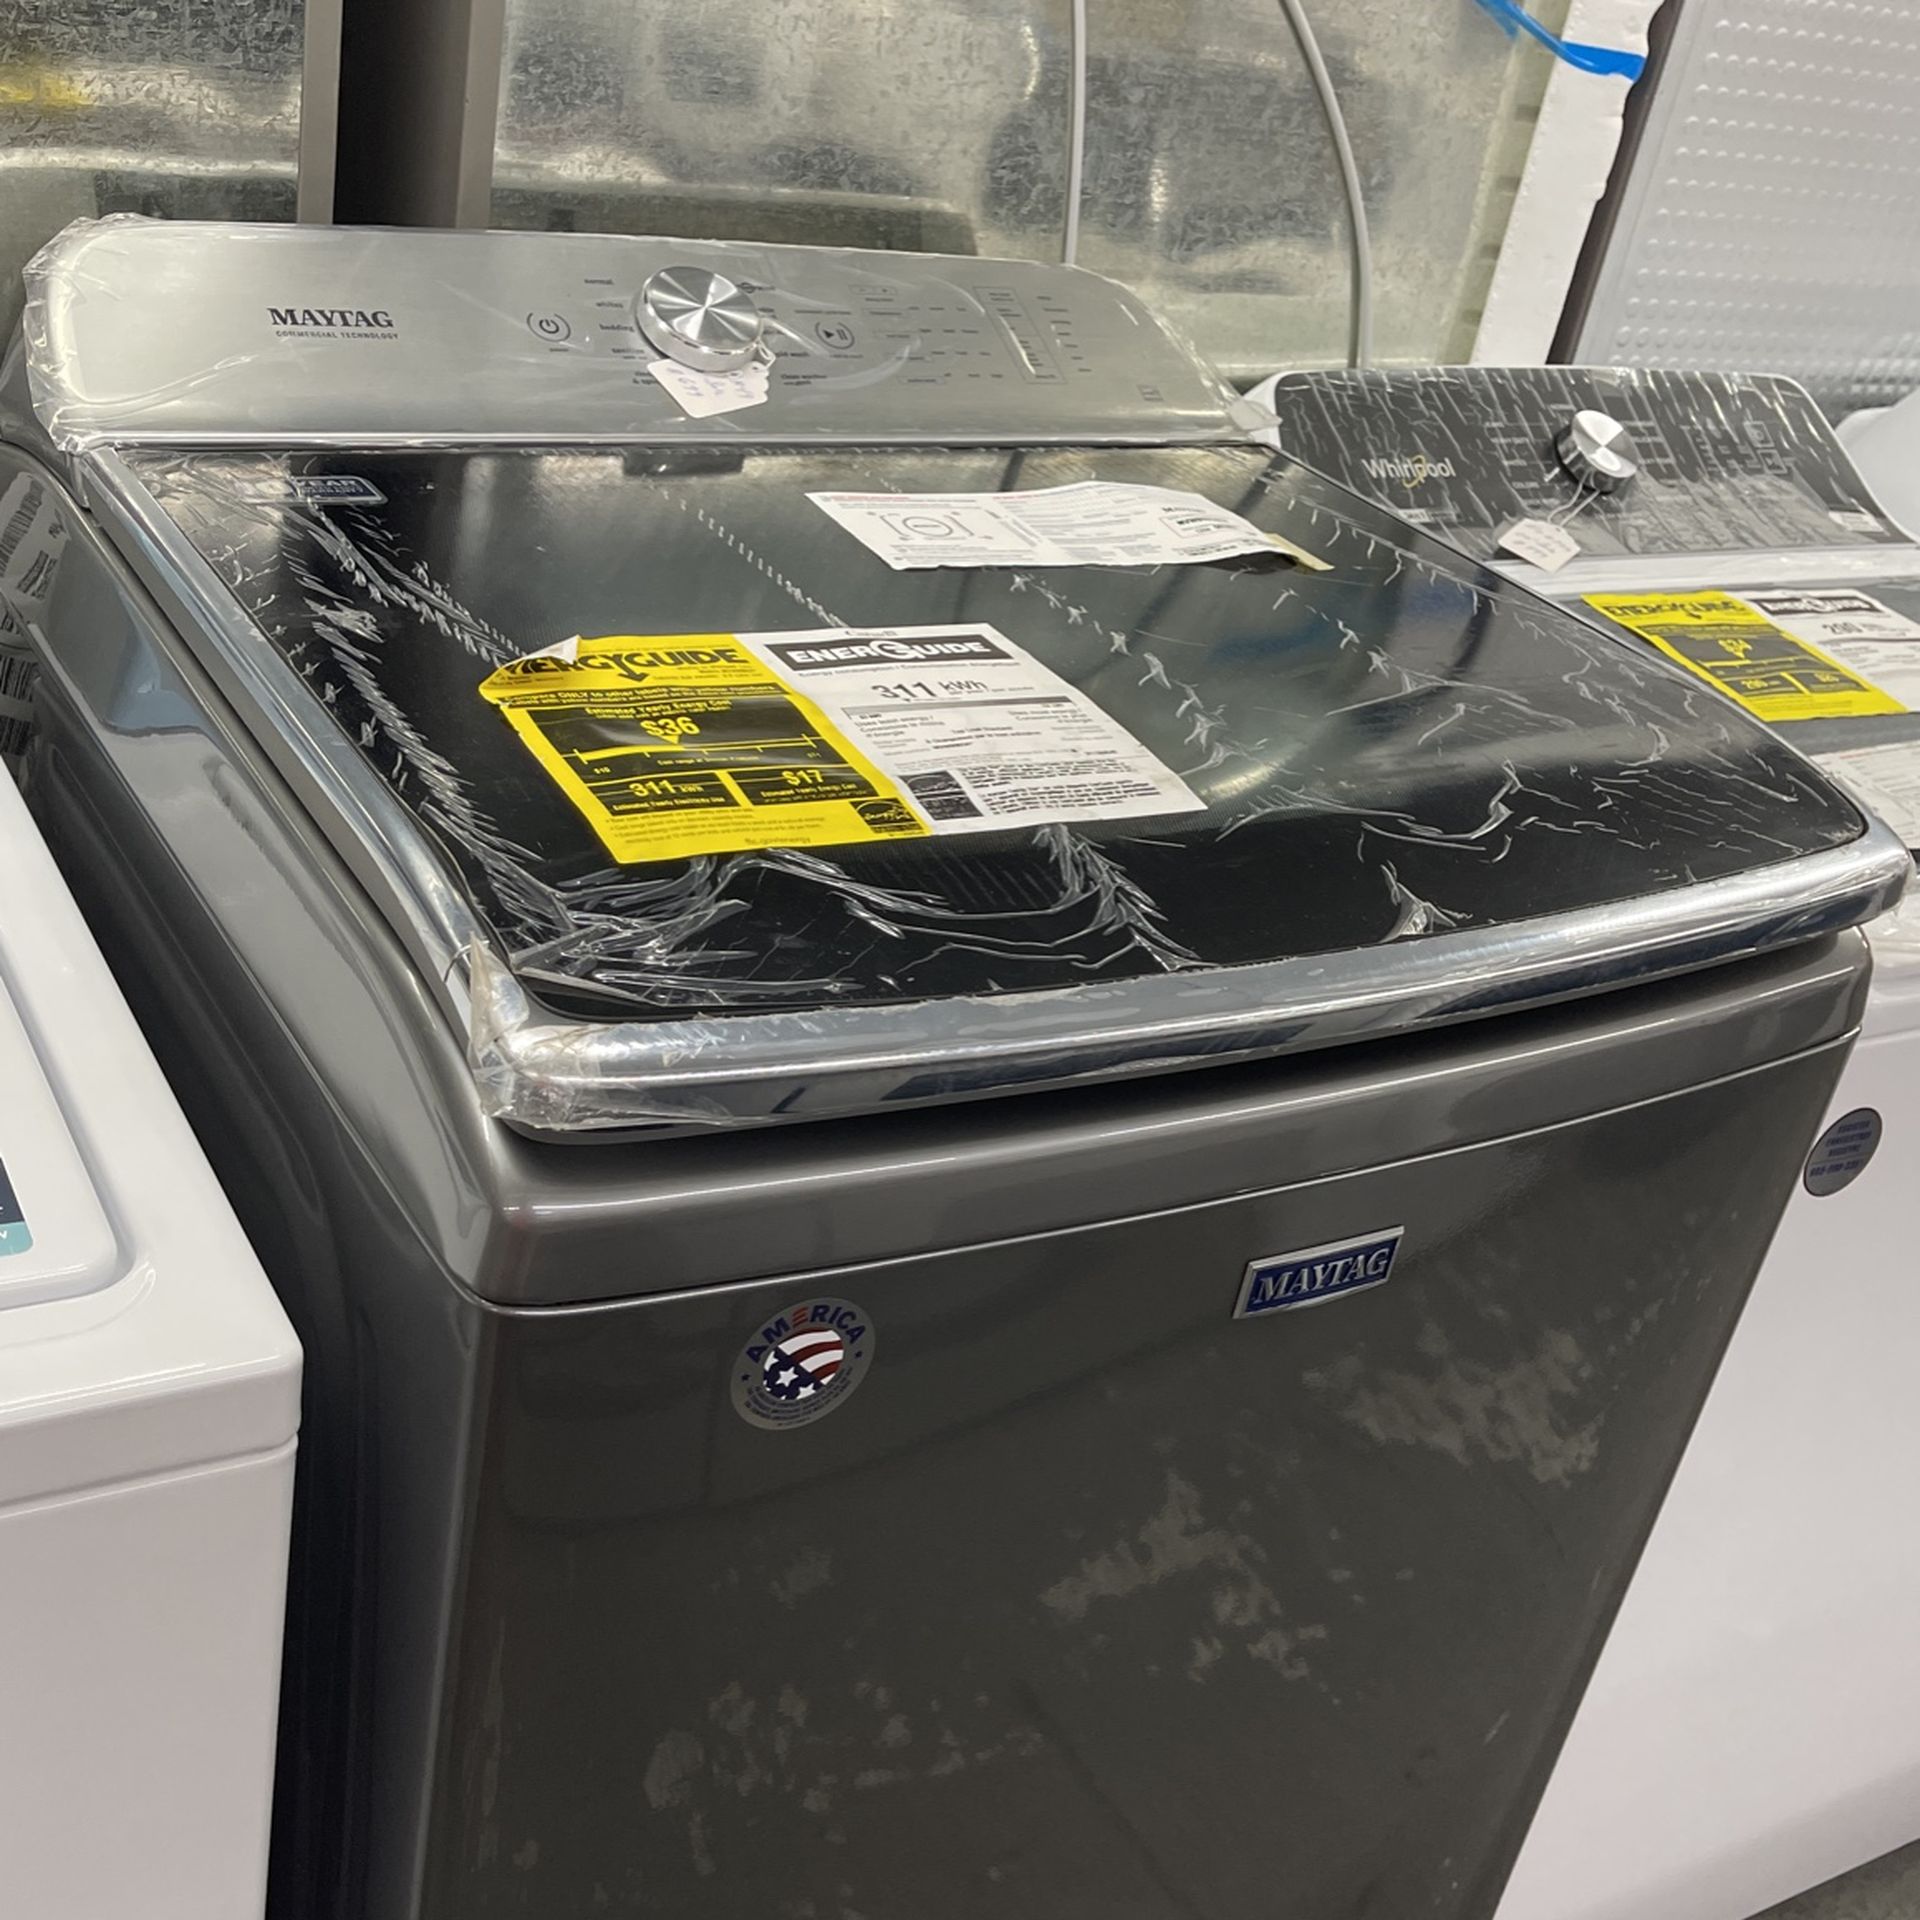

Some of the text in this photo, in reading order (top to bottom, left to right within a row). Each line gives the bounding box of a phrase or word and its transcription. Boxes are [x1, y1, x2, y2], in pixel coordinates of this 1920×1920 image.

[267, 307, 394, 328] MAYTAG
[275, 330, 399, 340] COMMERCIAL TECHNOLOGY
[1361, 456, 1457, 486] Whirlpool
[786, 640, 992, 664] ENERGUIDE
[871, 681, 988, 702] 311 kWh
[640, 717, 700, 737] $36
[629, 779, 677, 797] 311
[781, 769, 824, 786] $17
[1252, 1247, 1390, 1304] MAYTAG
[745, 1303, 867, 1364] AMERICA
